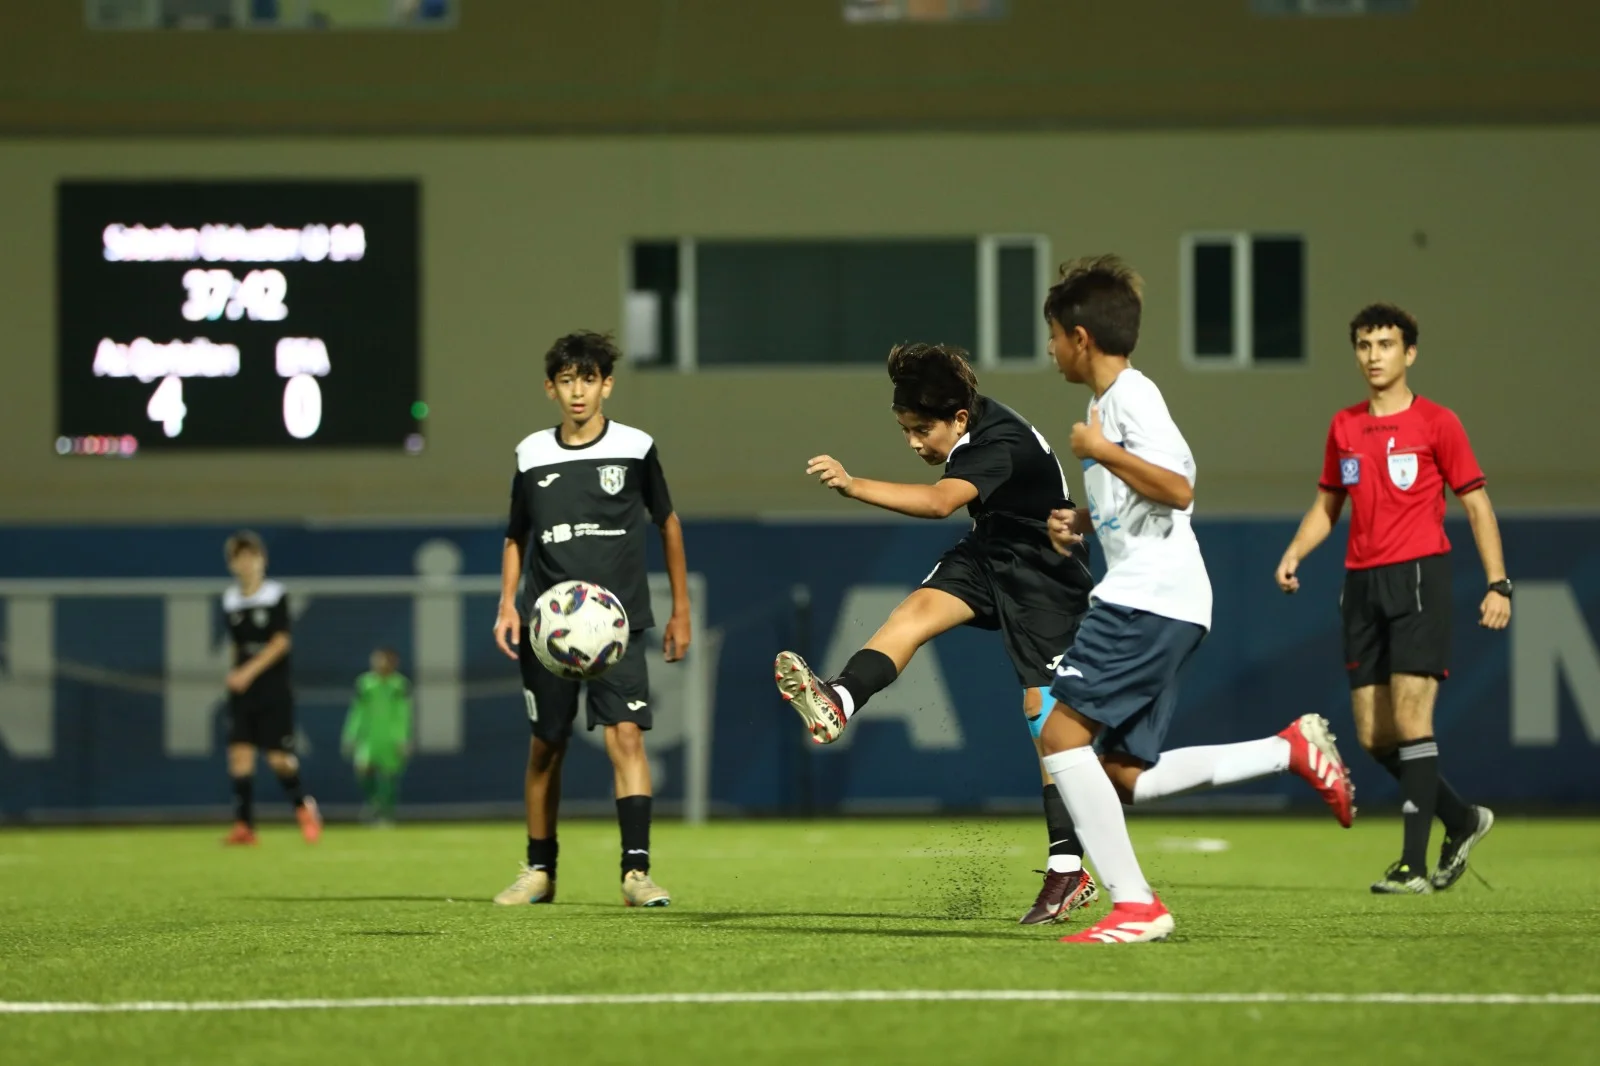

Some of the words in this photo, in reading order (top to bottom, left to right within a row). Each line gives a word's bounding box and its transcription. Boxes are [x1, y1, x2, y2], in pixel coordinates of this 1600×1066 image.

[182, 268, 288, 321] 37:42
[147, 374, 187, 438] 4
[283, 373, 322, 438] 0
